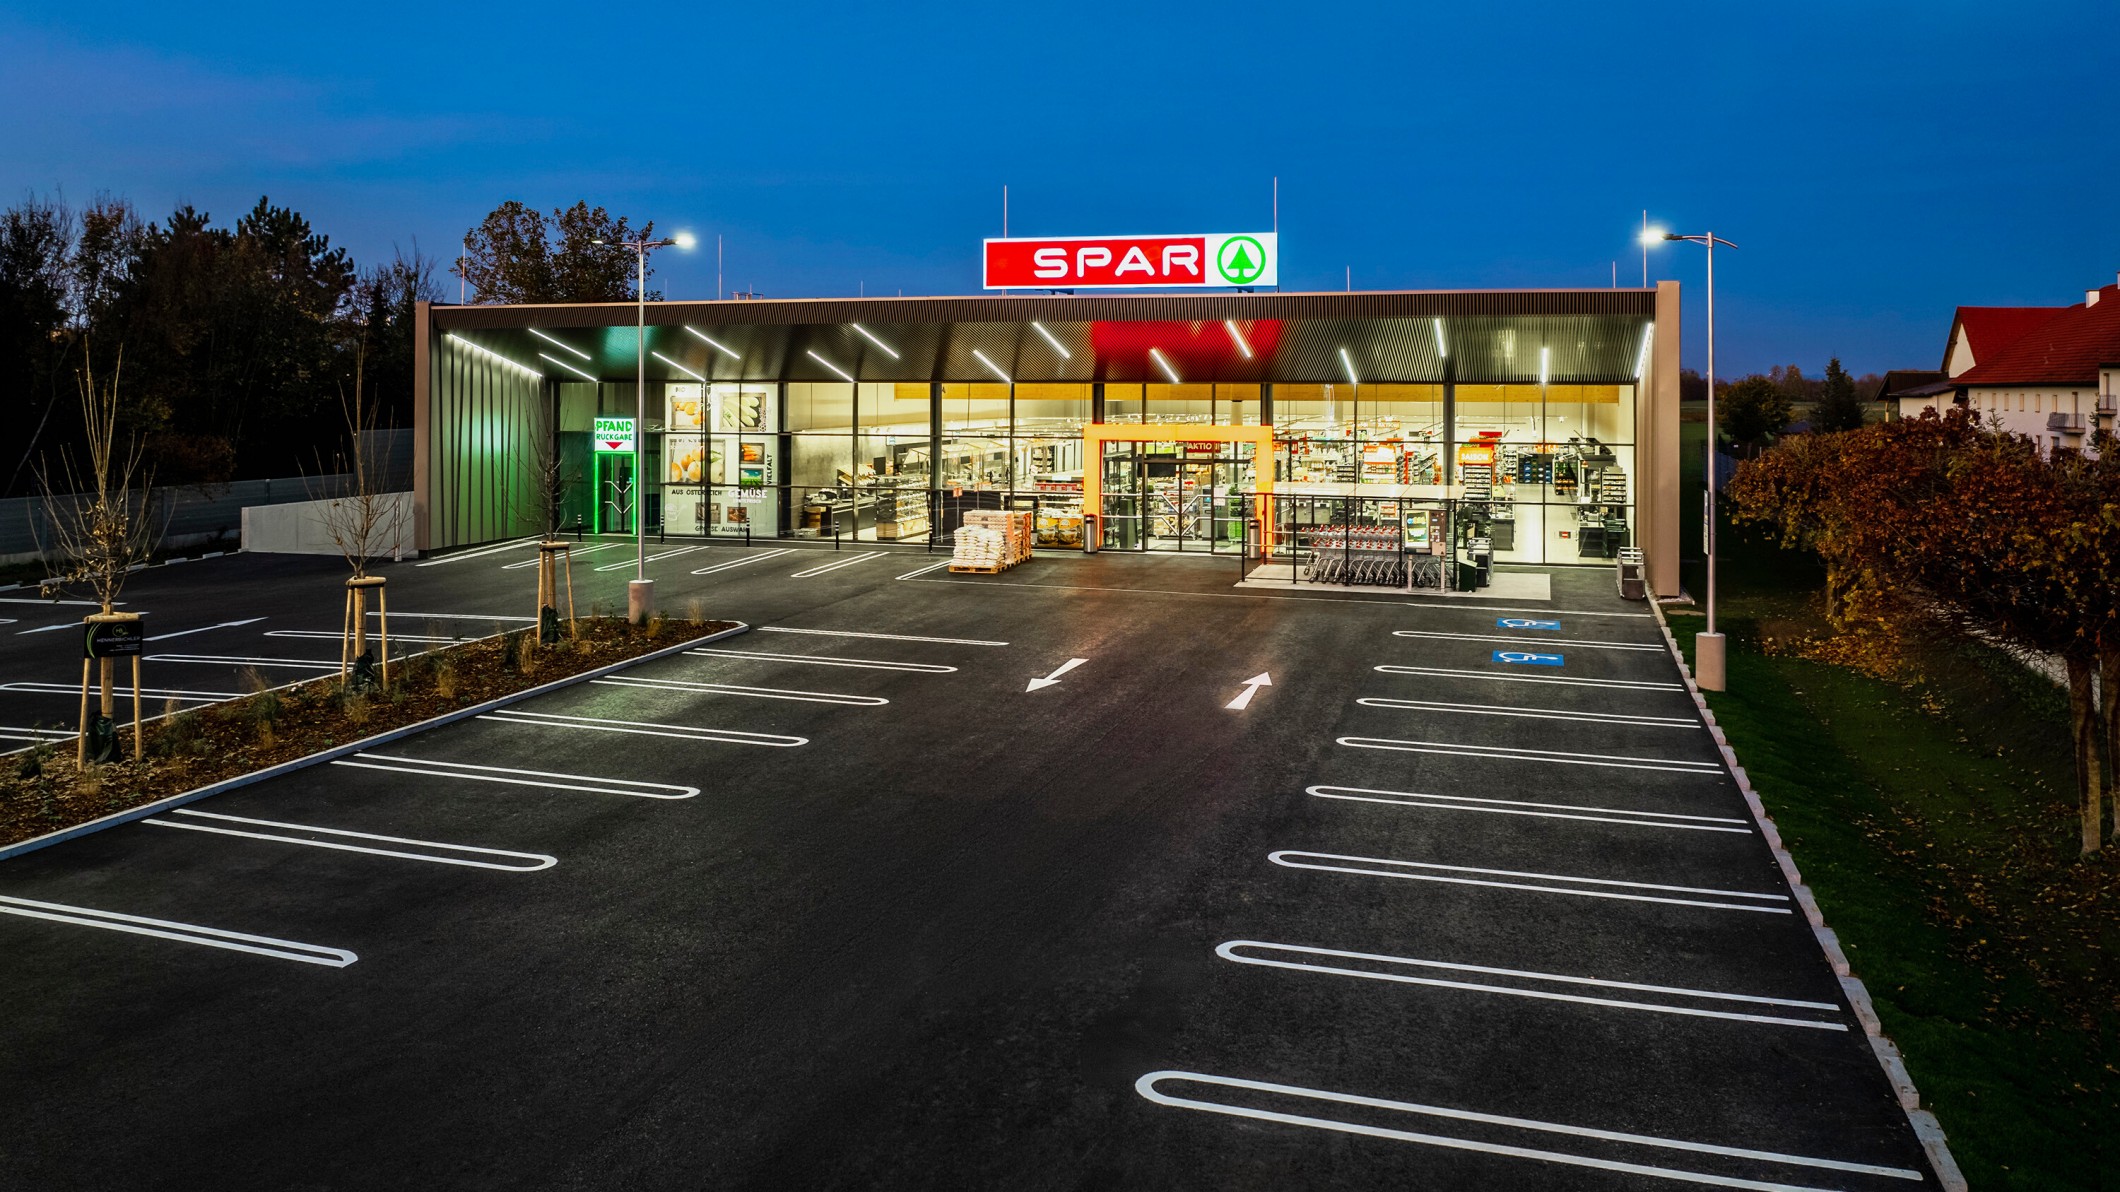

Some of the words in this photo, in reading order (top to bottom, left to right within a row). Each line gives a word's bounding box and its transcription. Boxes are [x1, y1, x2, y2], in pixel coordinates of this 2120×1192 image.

[1033, 244, 1199, 278] SPAR
[596, 420, 633, 431] PFAND
[728, 488, 768, 498] GEMÜSE
